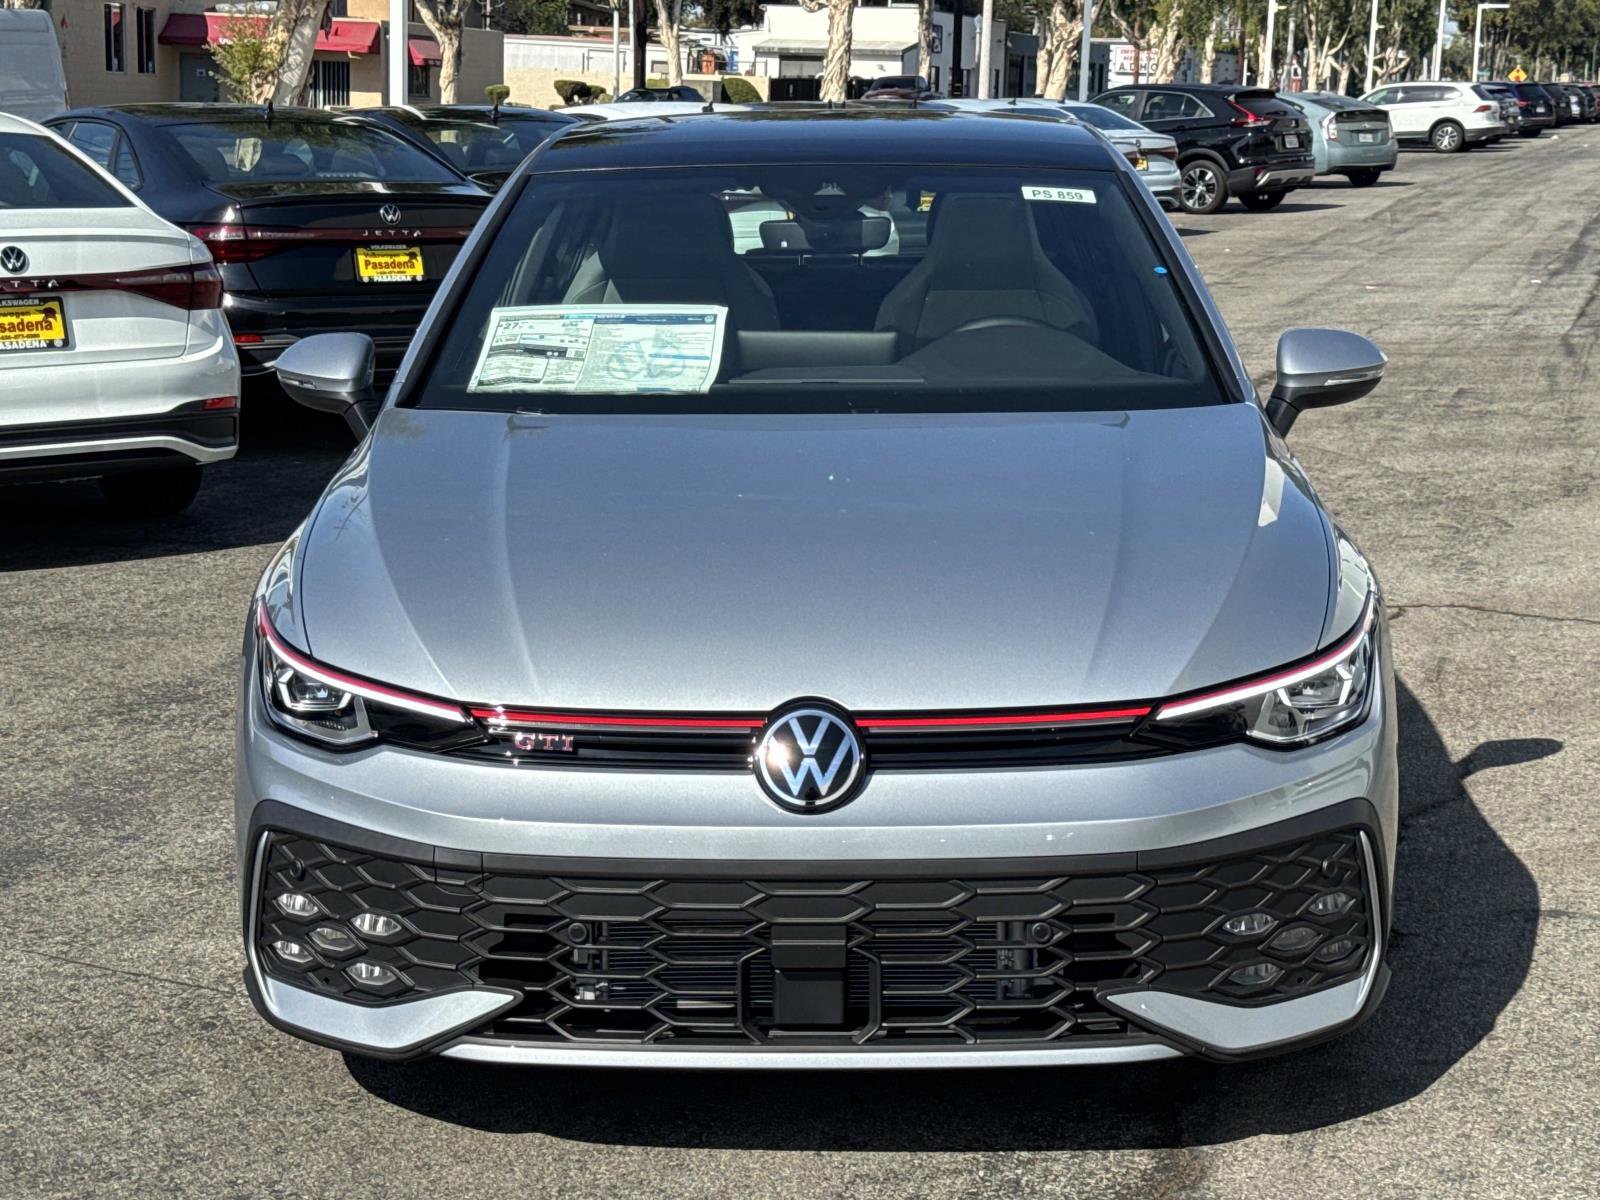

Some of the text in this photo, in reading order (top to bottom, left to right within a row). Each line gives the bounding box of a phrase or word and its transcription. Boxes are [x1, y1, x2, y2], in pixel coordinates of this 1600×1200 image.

[1032, 190, 1083, 200] PS 859
[364, 259, 416, 270] Pasadena
[515, 732, 573, 752] GTI
